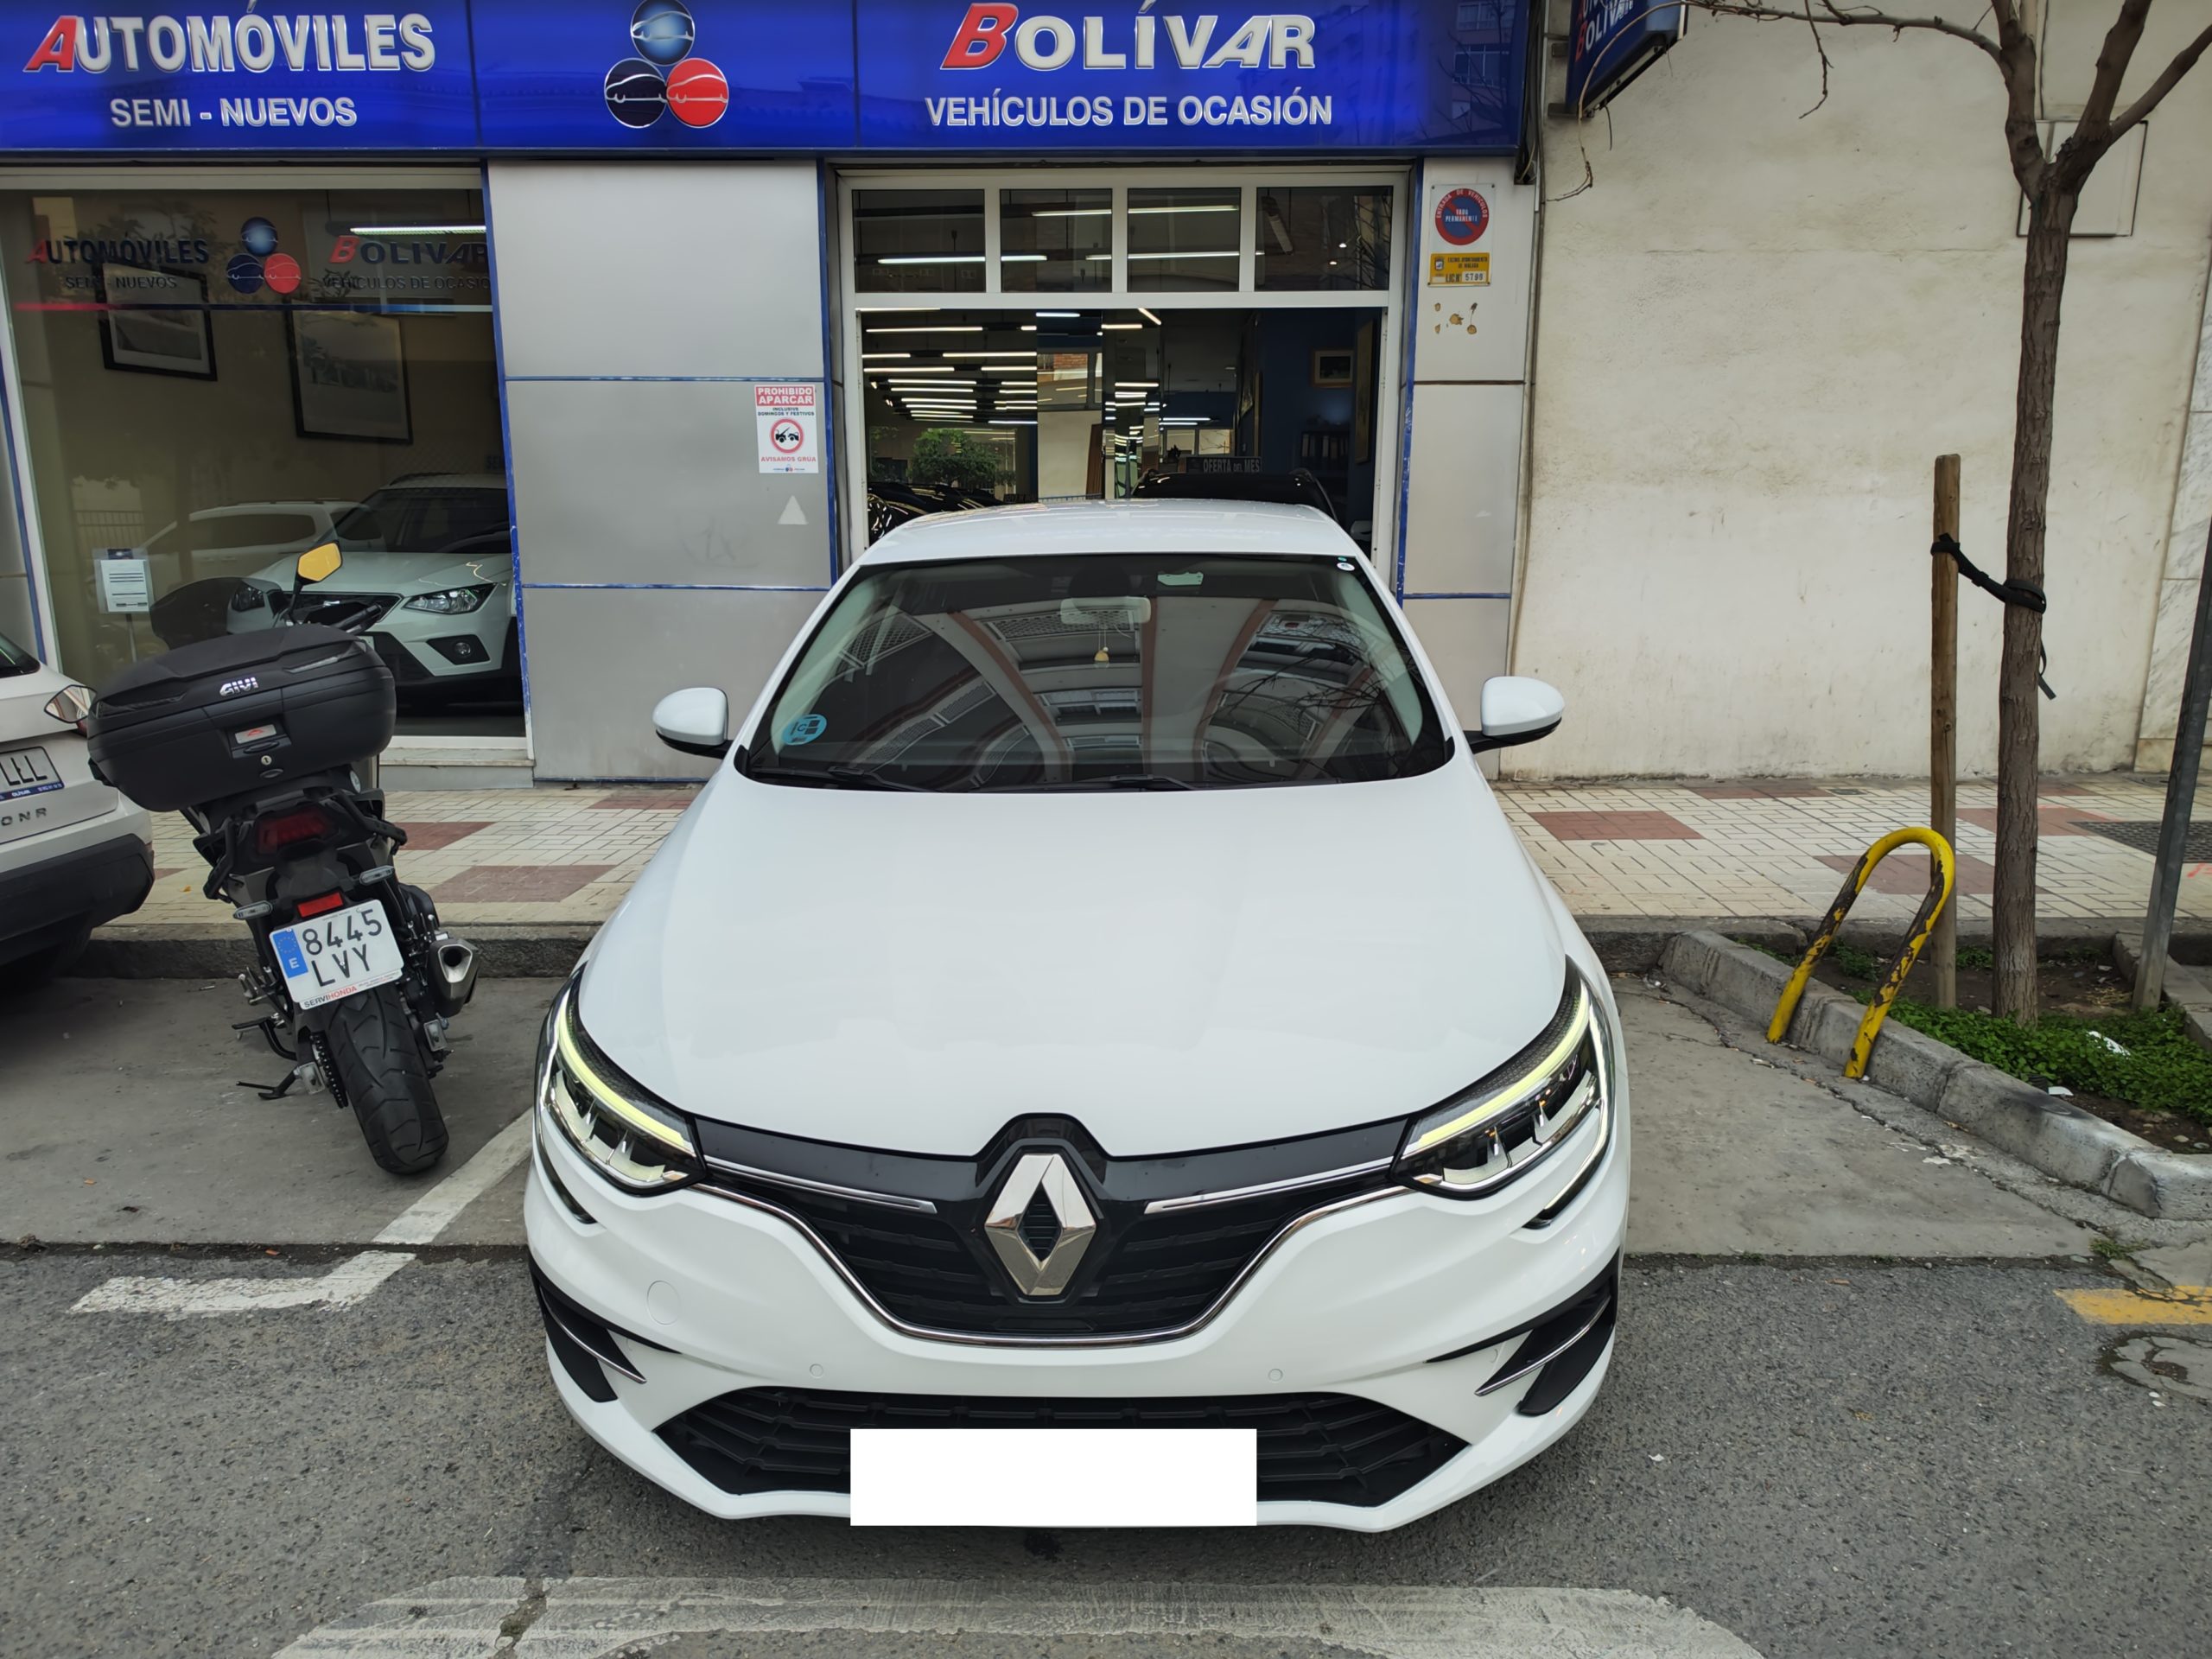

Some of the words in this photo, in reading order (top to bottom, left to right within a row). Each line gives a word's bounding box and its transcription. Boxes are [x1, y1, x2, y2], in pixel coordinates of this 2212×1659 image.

[22, 0, 435, 73] AUTOMÓVILES
[939, 0, 1316, 71] BOLÍVAR
[110, 98, 191, 128] SEMI
[219, 96, 358, 128] NUEVOS
[925, 87, 1114, 127] VEHÍCULOS
[1123, 96, 1168, 126] DE
[1177, 86, 1332, 127] OCASIÓN
[116, 276, 178, 289] NUEVOS
[410, 276, 430, 289] DE
[758, 387, 812, 396] PROHIBIDO
[759, 395, 813, 404] APARCAR
[1203, 458, 1231, 473] OFERTA
[1244, 458, 1260, 473] MES
[219, 677, 259, 696] GIVI
[302, 908, 382, 956] 8445
[289, 957, 300, 969] E
[311, 944, 370, 988] LVY
[303, 985, 358, 1008] SERVIHONDA
